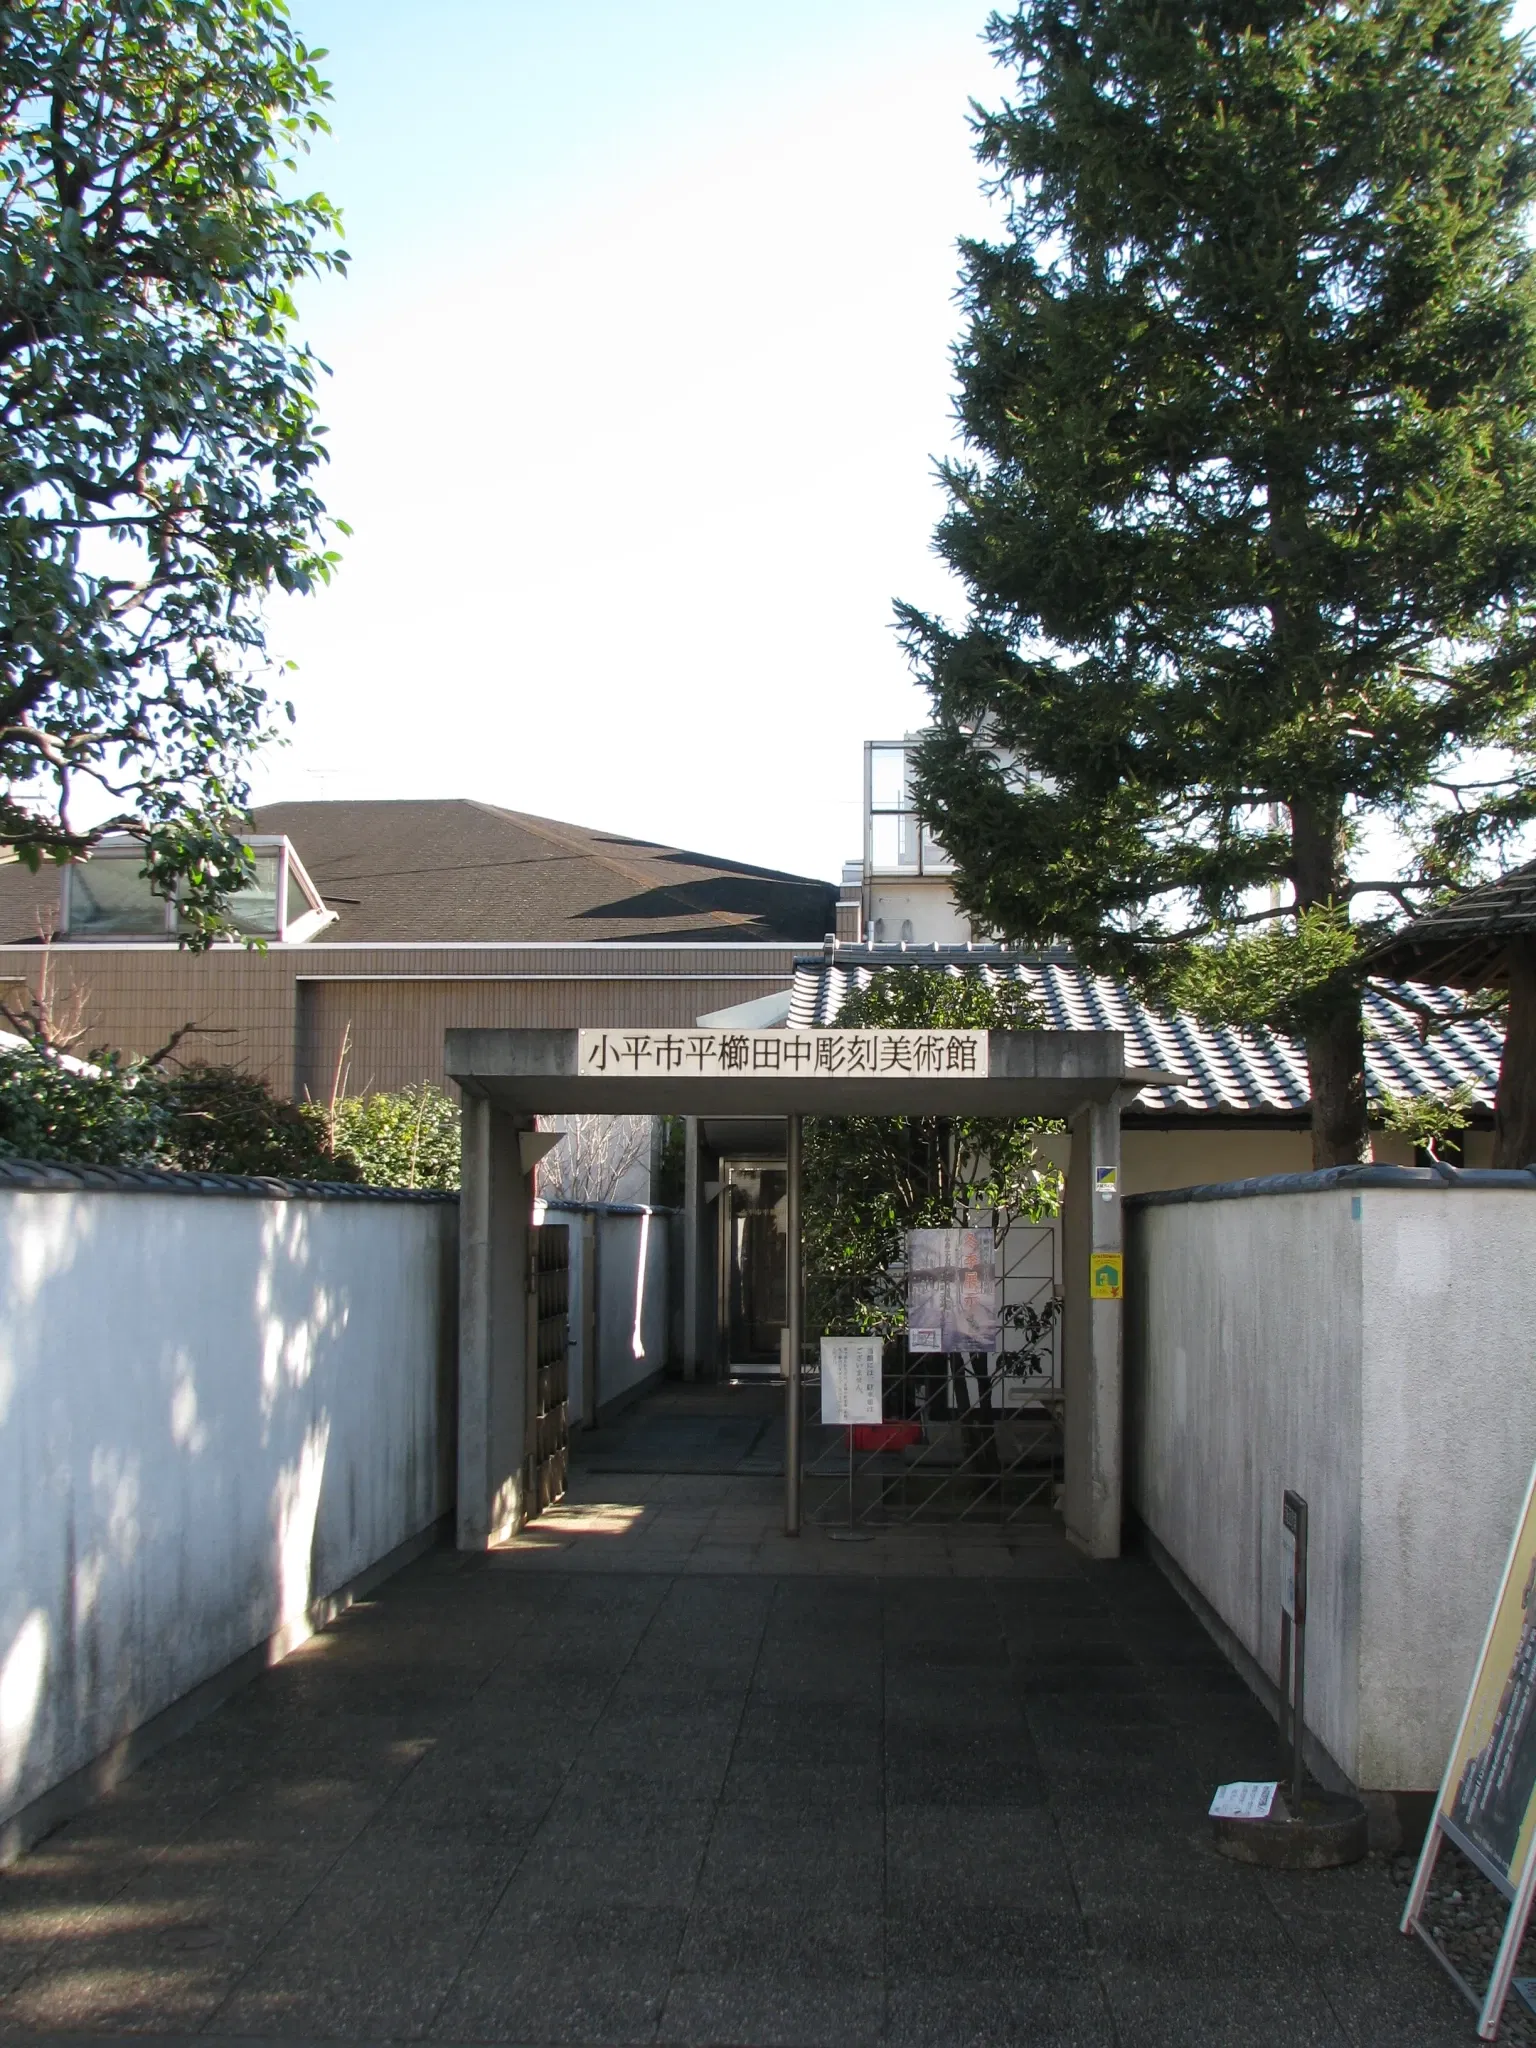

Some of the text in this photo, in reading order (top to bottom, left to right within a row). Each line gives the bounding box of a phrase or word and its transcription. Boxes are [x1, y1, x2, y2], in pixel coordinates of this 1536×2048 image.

[588, 1034, 978, 1072] 小平市平櫛田中彫刻美術館
[963, 1231, 980, 1308] 冬季展示
